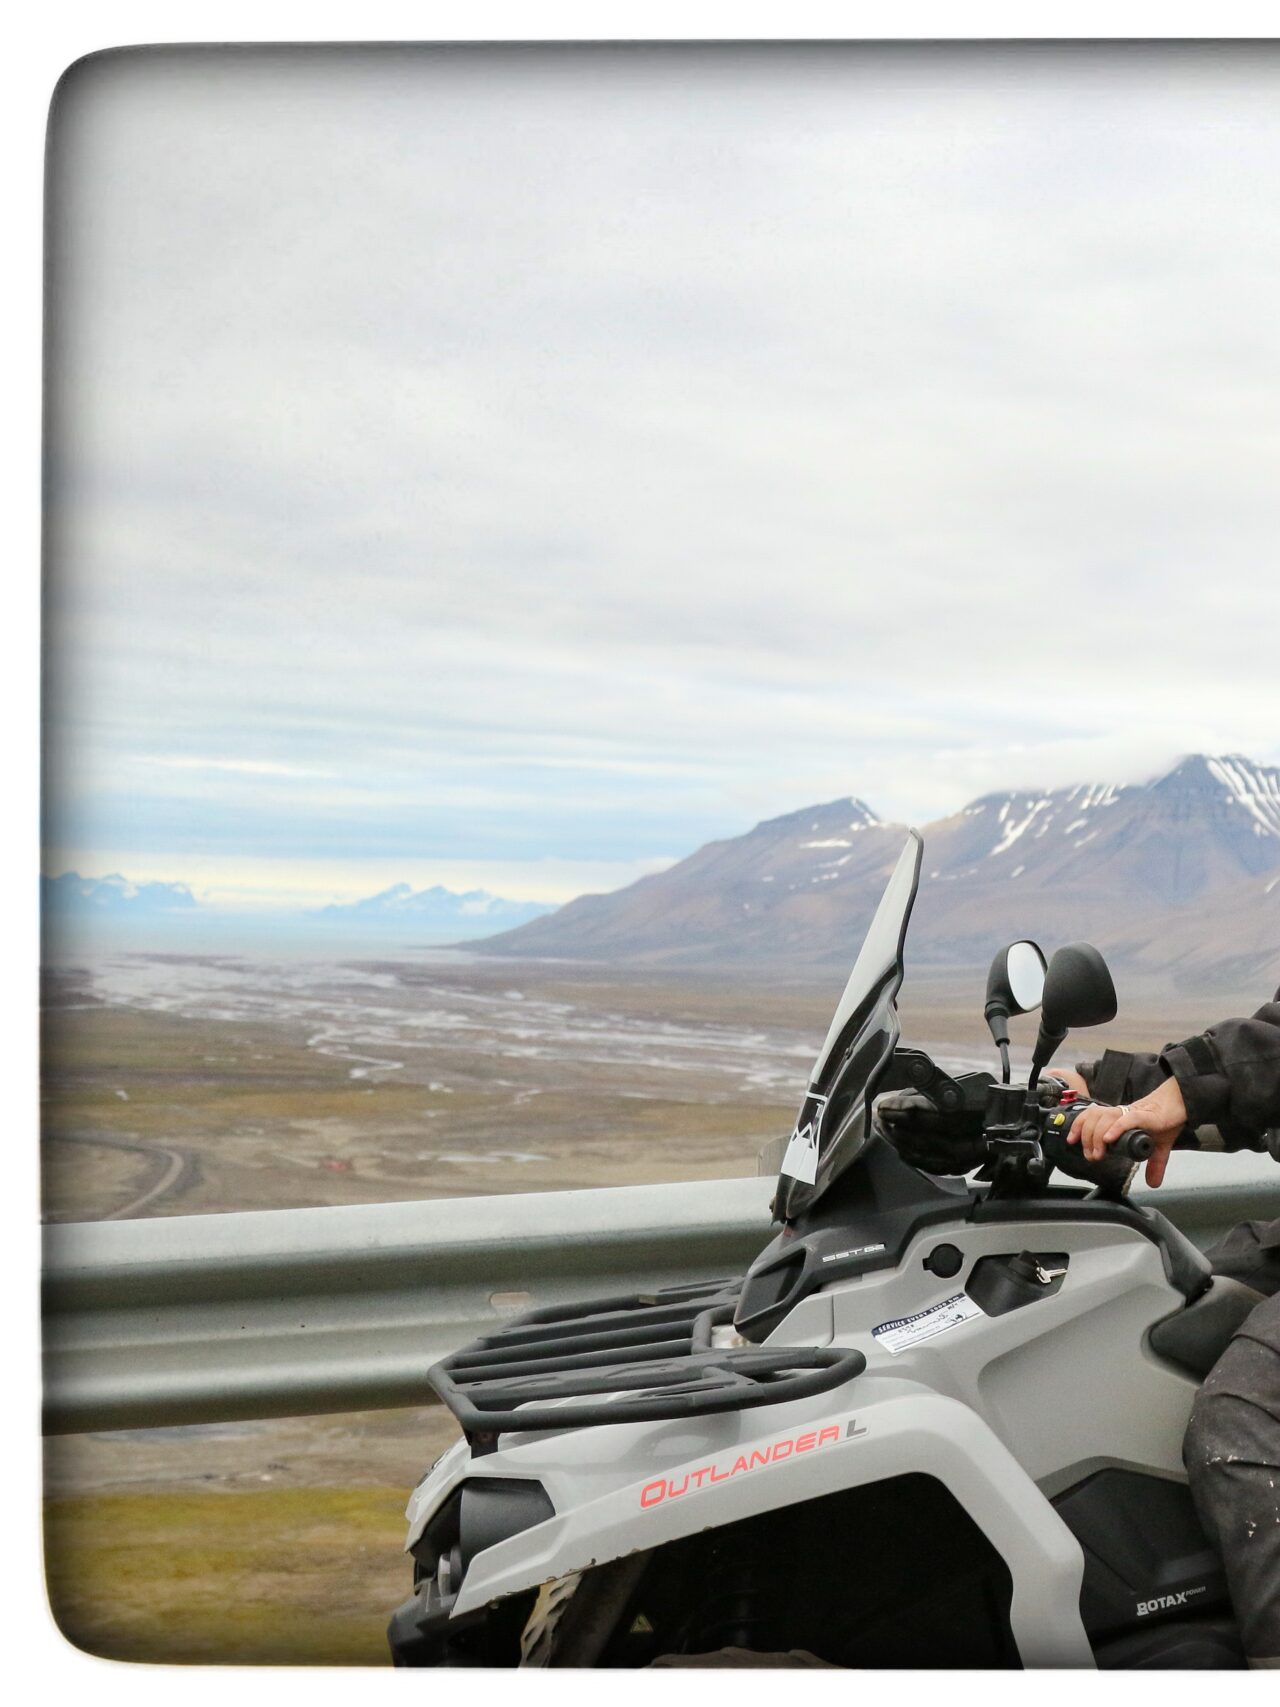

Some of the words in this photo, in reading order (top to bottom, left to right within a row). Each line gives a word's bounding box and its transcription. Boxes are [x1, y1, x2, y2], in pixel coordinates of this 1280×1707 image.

[878, 1320, 906, 1334] SERVICE
[906, 1311, 928, 1323] EVERY
[640, 1425, 840, 1508] OUTLANDER
[846, 1419, 868, 1438] L
[1136, 1591, 1187, 1616] ROTAX
